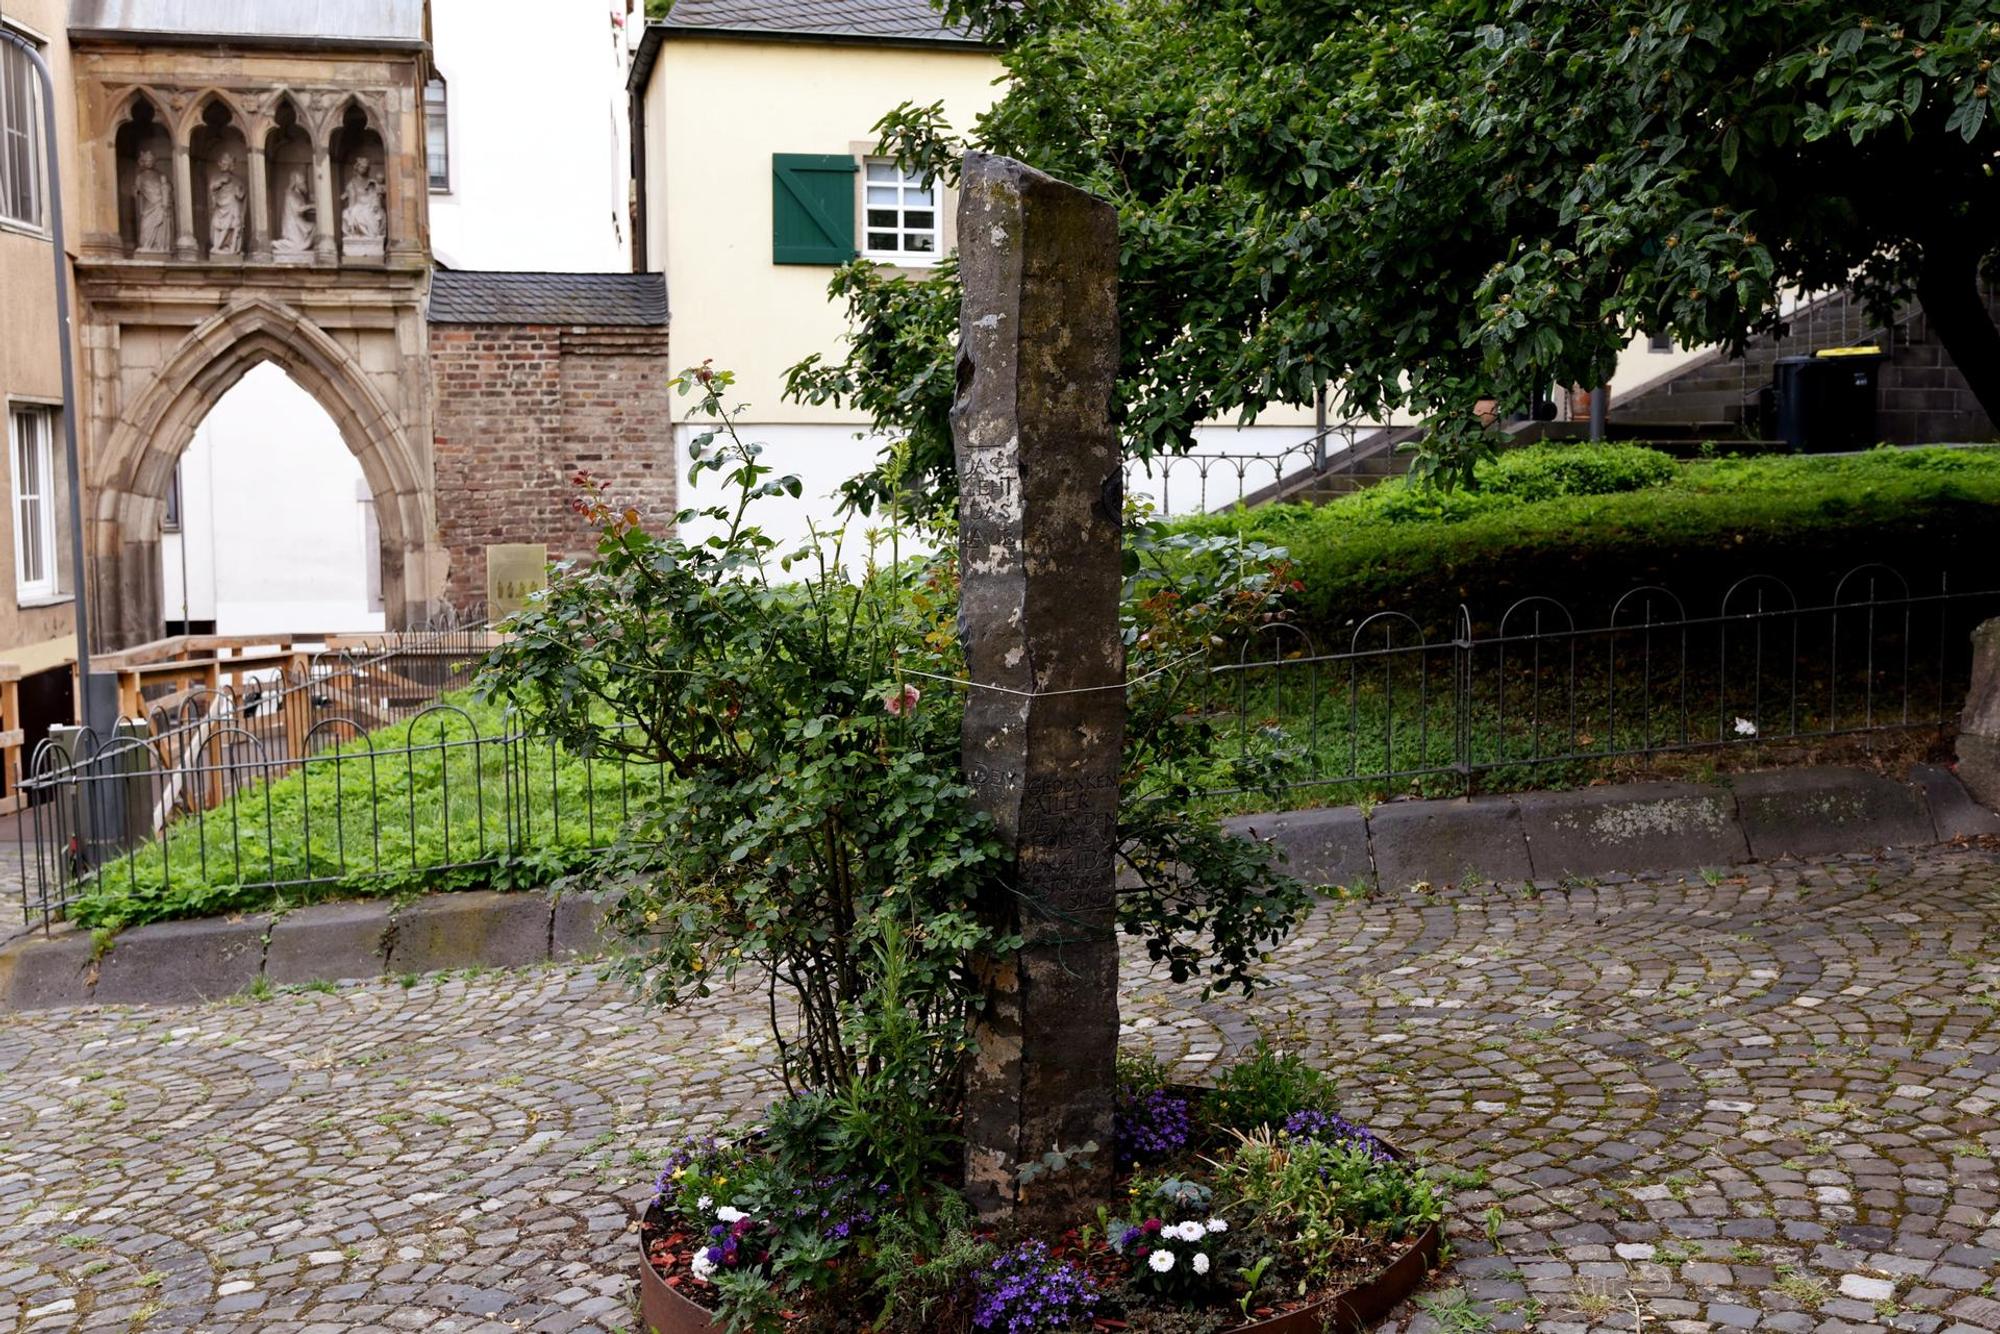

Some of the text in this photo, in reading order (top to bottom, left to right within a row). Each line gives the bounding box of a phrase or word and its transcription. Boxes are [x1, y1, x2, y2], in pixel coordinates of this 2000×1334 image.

[1028, 774, 1118, 796] GEDENKEN
[1031, 793, 1090, 815] ALLER
[1083, 811, 1118, 832] DEN
[1057, 849, 1114, 872] AIDS
